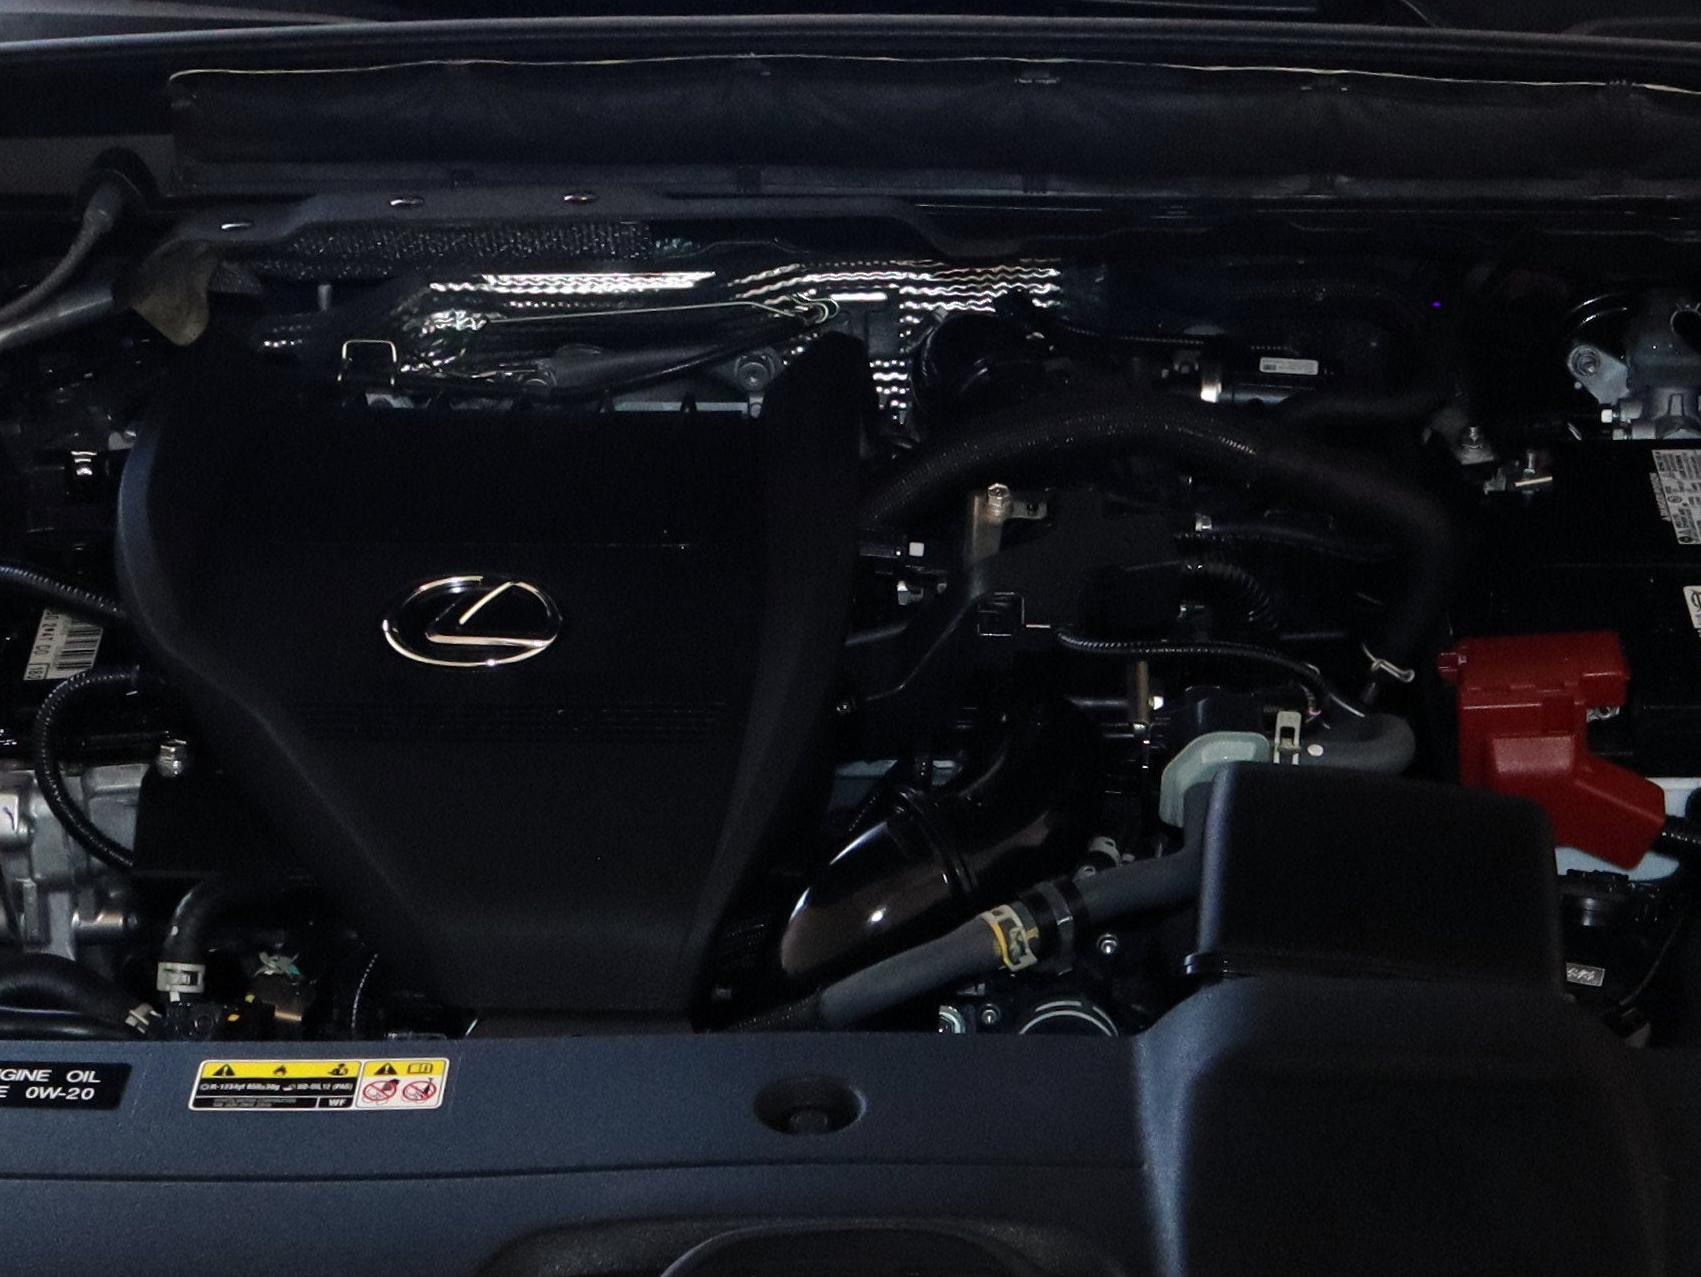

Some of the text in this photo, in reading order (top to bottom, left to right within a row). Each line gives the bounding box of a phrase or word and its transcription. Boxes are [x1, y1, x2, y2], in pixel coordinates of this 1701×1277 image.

[66, 1069, 102, 1084] OIL
[25, 1086, 96, 1101] 0W-20
[328, 1098, 347, 1107] WF
